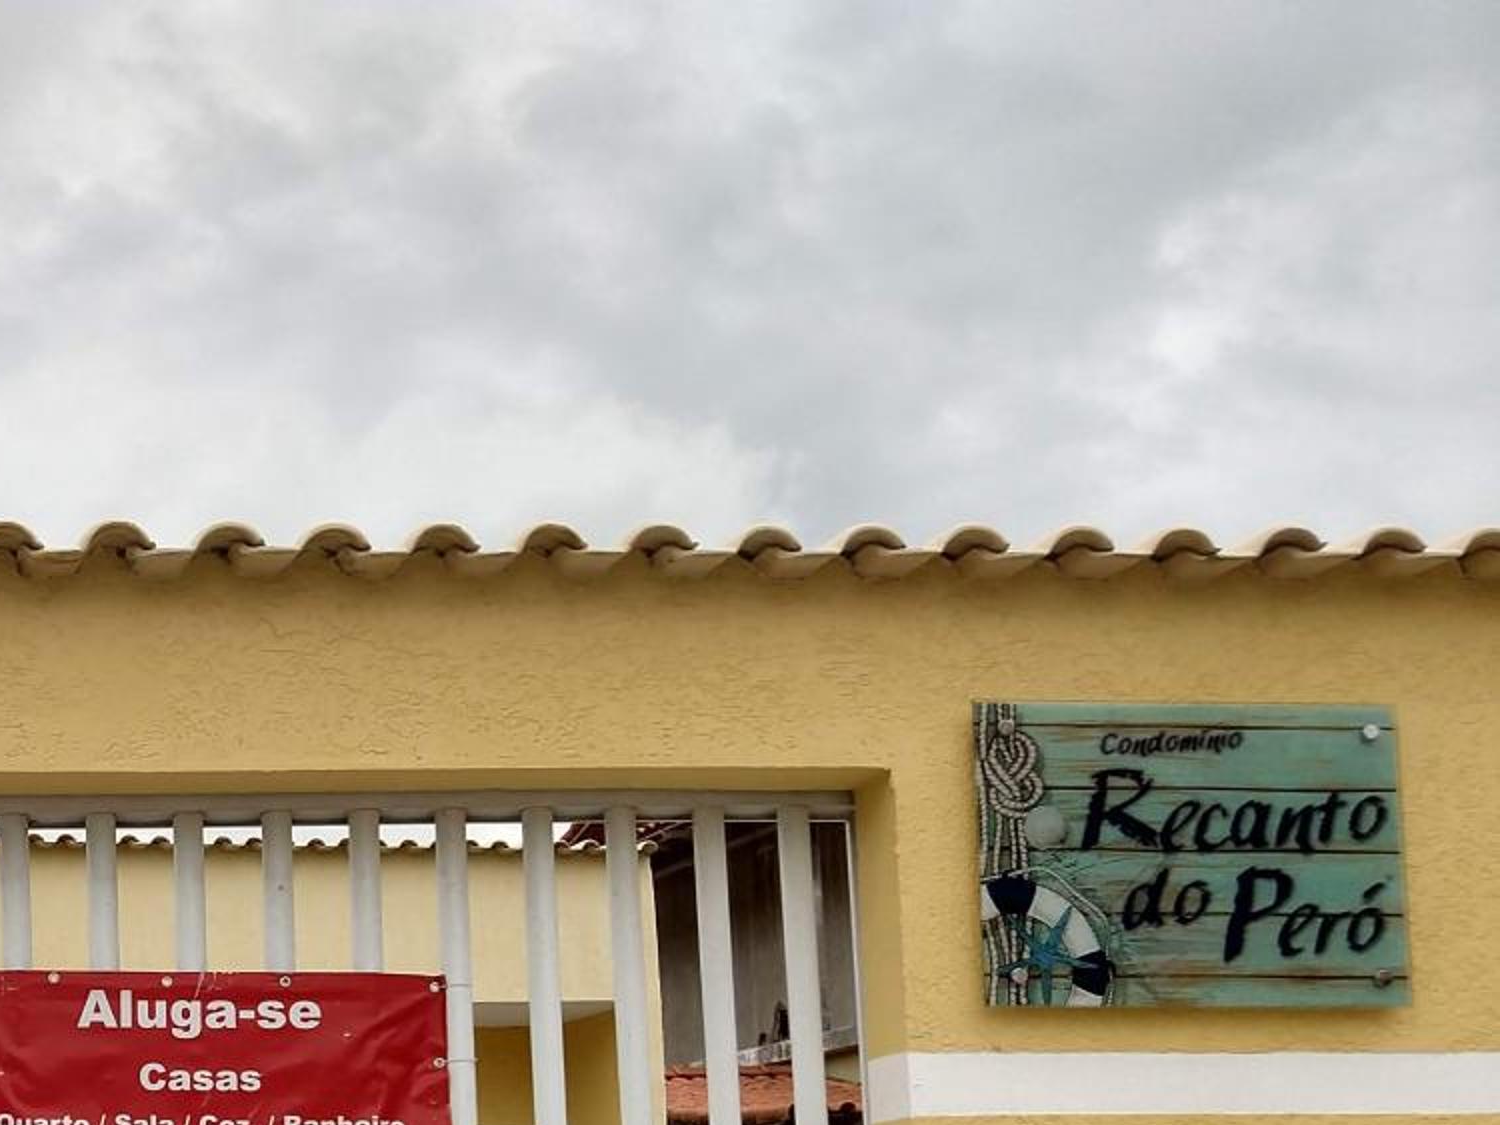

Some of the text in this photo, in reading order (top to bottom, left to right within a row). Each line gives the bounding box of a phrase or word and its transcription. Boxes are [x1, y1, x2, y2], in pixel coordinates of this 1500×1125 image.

[1082, 767, 1389, 854] Recanto
[1123, 865, 1387, 963] do Peró
[77, 989, 322, 1039] Aluga-se
[138, 1062, 262, 1093] Casas
